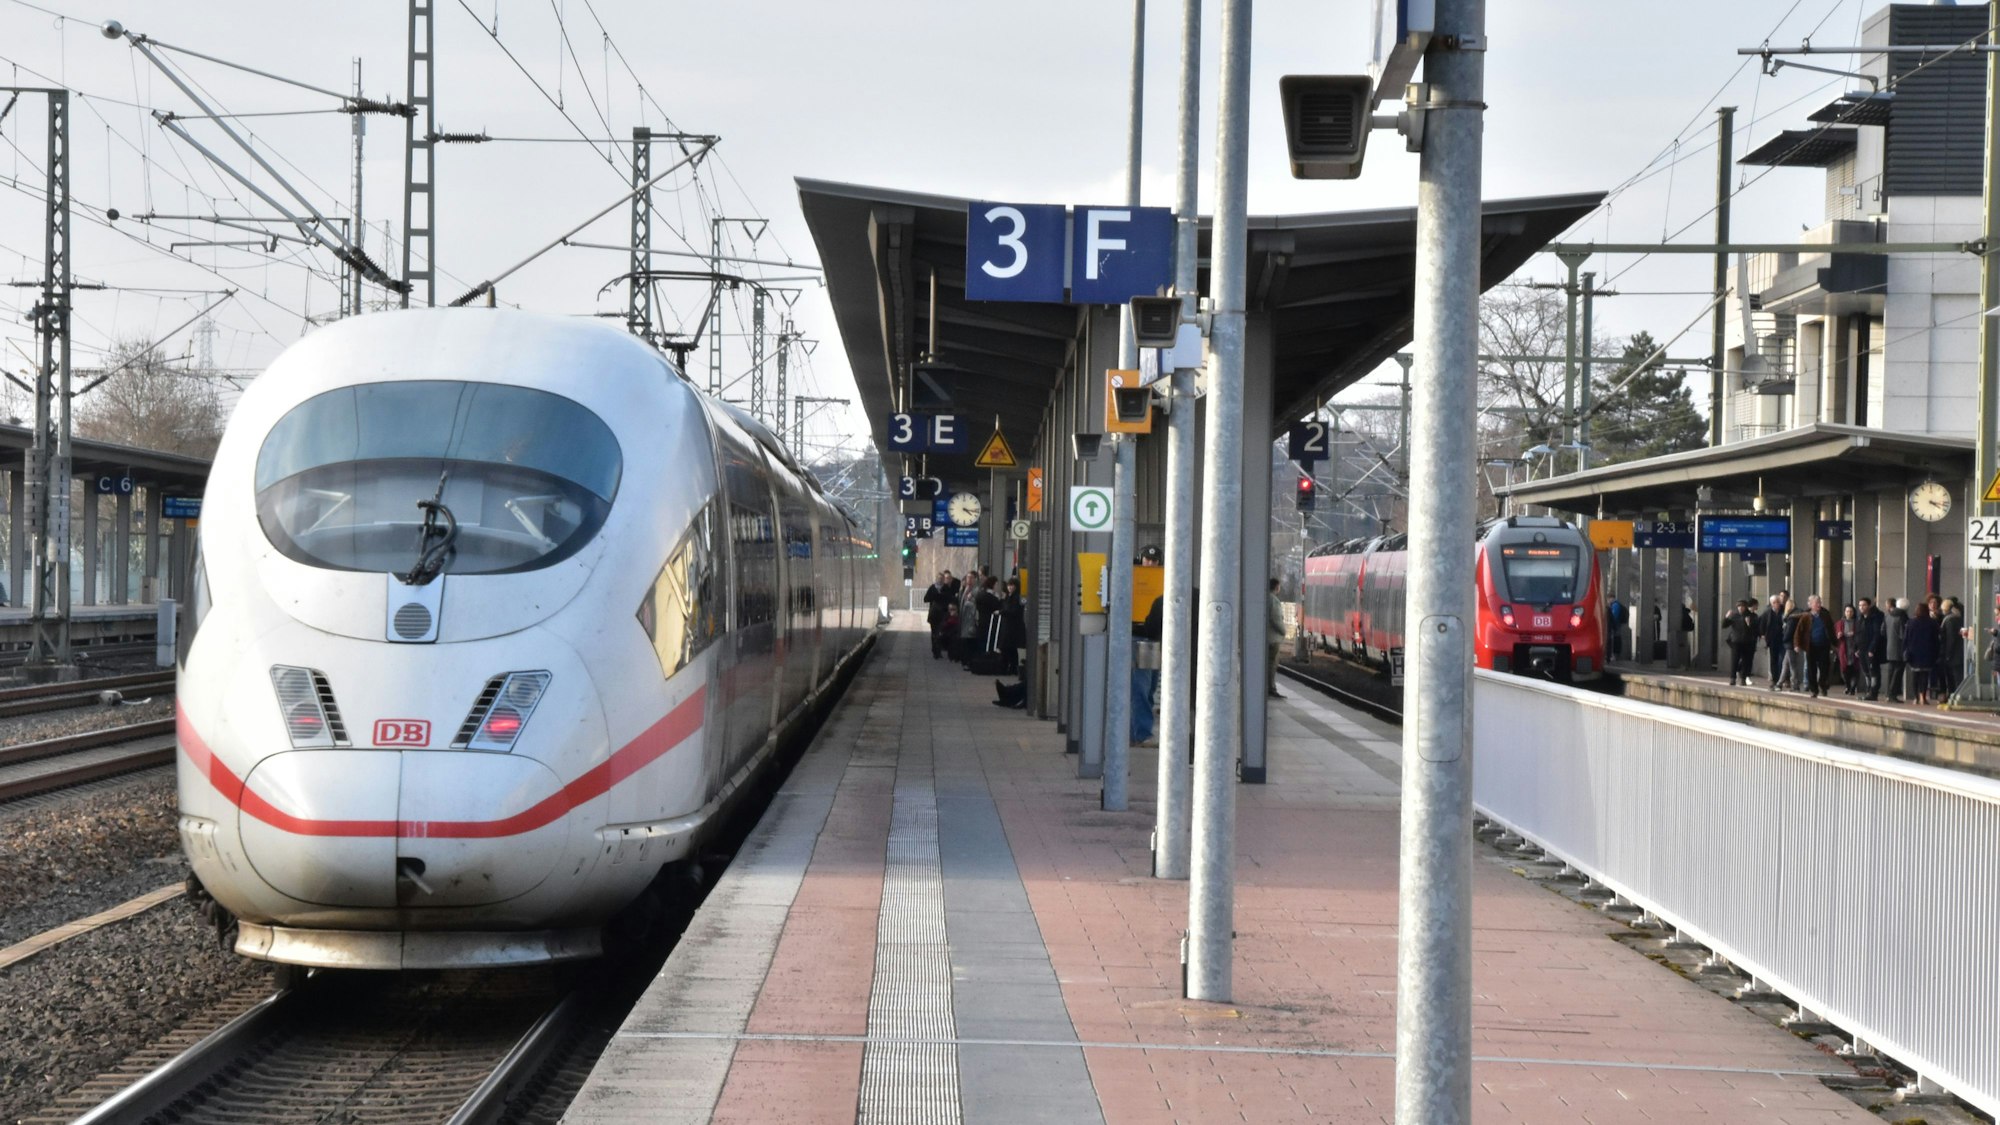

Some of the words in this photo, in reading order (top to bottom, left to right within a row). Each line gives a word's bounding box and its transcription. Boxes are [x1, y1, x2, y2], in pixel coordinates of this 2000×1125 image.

[981, 206, 1028, 278] 3
[1085, 209, 1131, 280] F
[893, 413, 913, 444] 3
[934, 415, 954, 444] E
[1304, 422, 1323, 451] 2
[99, 477, 111, 491] C
[120, 477, 131, 492] 6
[902, 476, 914, 495] 3
[908, 517, 916, 529] 3
[922, 518, 931, 529] B
[1657, 522, 1676, 533] 2-3
[1687, 522, 1695, 534] 6
[1971, 520, 1999, 540] 24
[1978, 545, 1992, 563] 4
[1535, 617, 1551, 626] DB
[1393, 657, 1404, 674] H
[377, 721, 427, 744] DB
